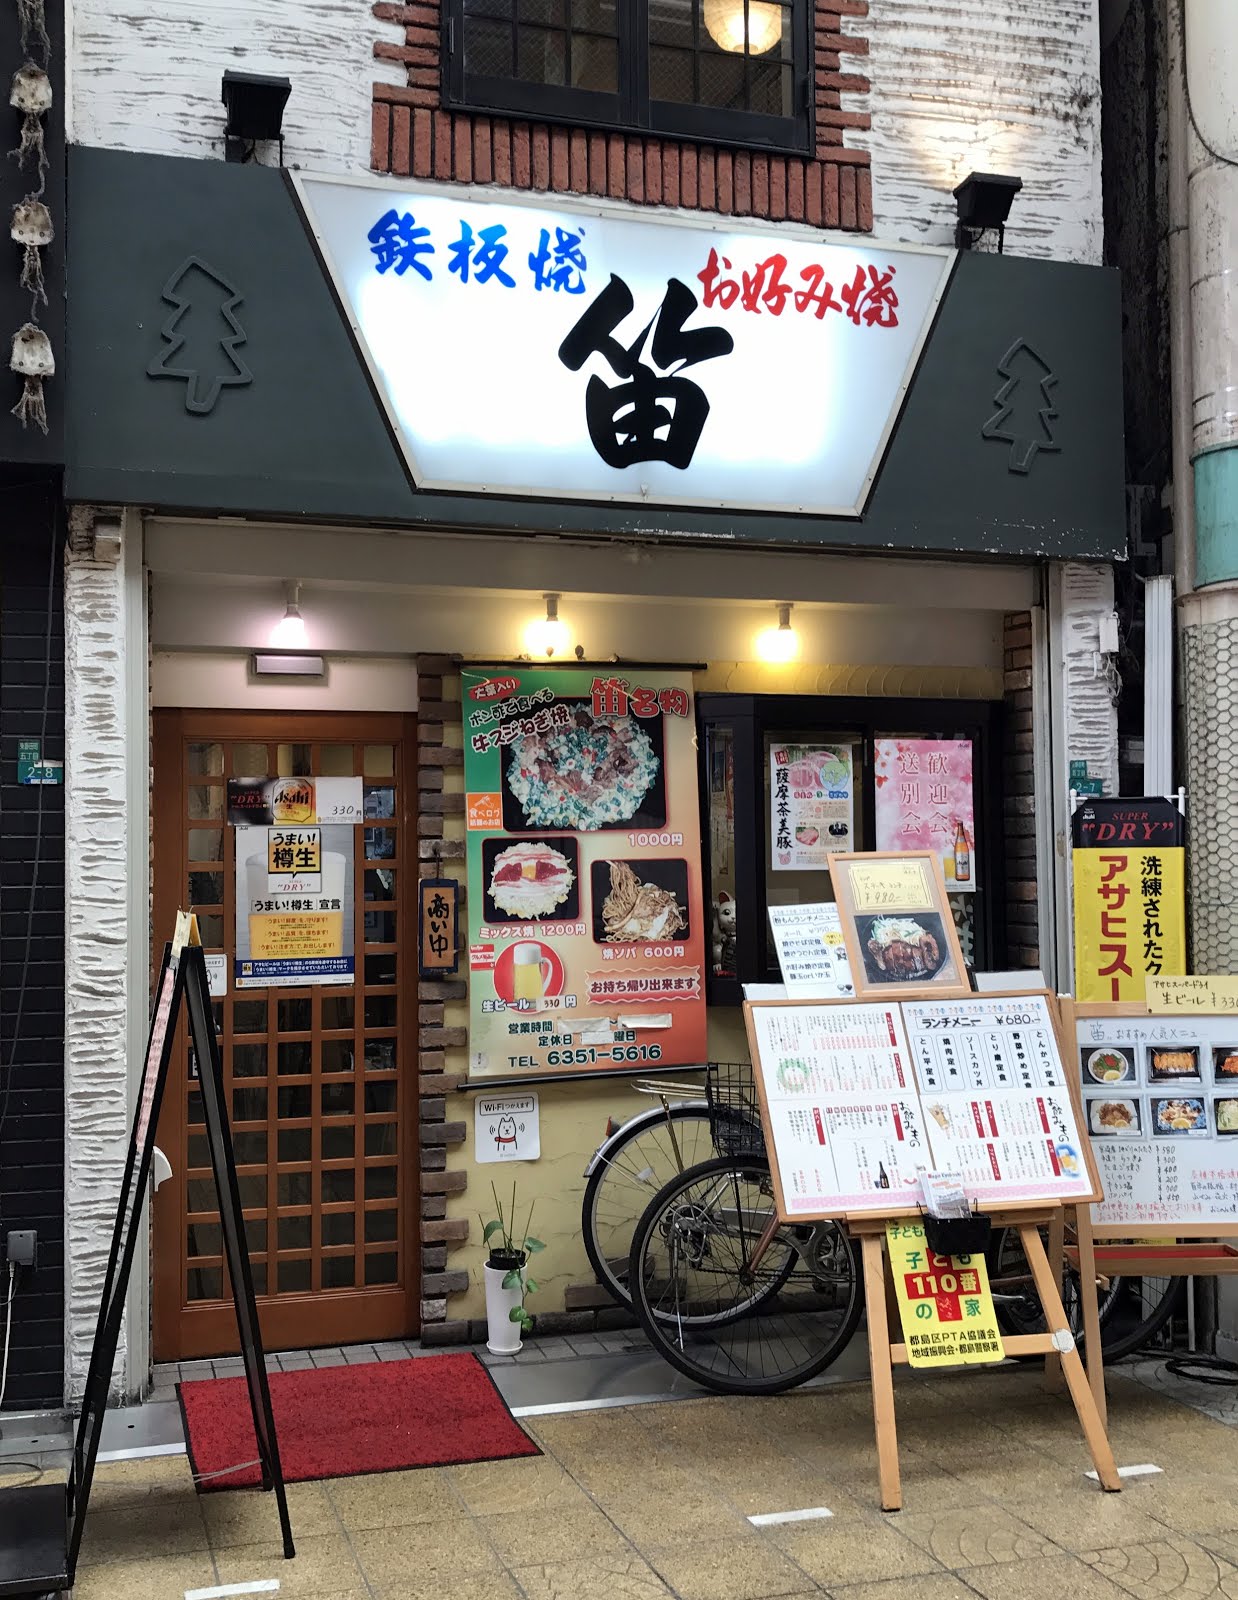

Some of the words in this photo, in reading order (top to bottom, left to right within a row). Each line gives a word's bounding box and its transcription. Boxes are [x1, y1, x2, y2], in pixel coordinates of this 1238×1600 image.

[367, 208, 588, 295] 鉄板焼
[697, 247, 900, 328] お好み焼
[558, 272, 735, 470] 笛
[475, 679, 516, 699] 大葉入り
[590, 676, 688, 718] 笛名物
[469, 687, 554, 727] ポン酢で食べる
[472, 704, 570, 753] 牛スジねぎ焼
[27, 766, 54, 778] 2-8
[900, 752, 921, 835] 送別会
[927, 752, 949, 835] 歓迎会
[1076, 782, 1096, 793] 2-7
[274, 790, 308, 805] Asahi
[1112, 812, 1148, 820] SUPER
[628, 834, 683, 847] 1000円
[272, 848, 317, 868] 樽生
[480, 925, 534, 939] ミックス焼
[541, 923, 586, 936] 1200円
[602, 948, 636, 960] 焼ソバ
[644, 945, 685, 958] 600円
[590, 977, 696, 994] お持ち帰り出来ます
[482, 998, 530, 1013] 生ビール
[1162, 992, 1206, 1005] 生ビール
[508, 1021, 553, 1034] 営業時間
[538, 1034, 573, 1047] 定休日
[508, 1056, 538, 1068] TEL
[547, 1044, 662, 1066] 6351-5616
[890, 1226, 925, 1240] 子ども
[912, 1272, 976, 1295] 110番
[916, 1303, 932, 1320] の
[965, 1298, 981, 1316] 家
[909, 1329, 996, 1345] 都島区PTA協議会
